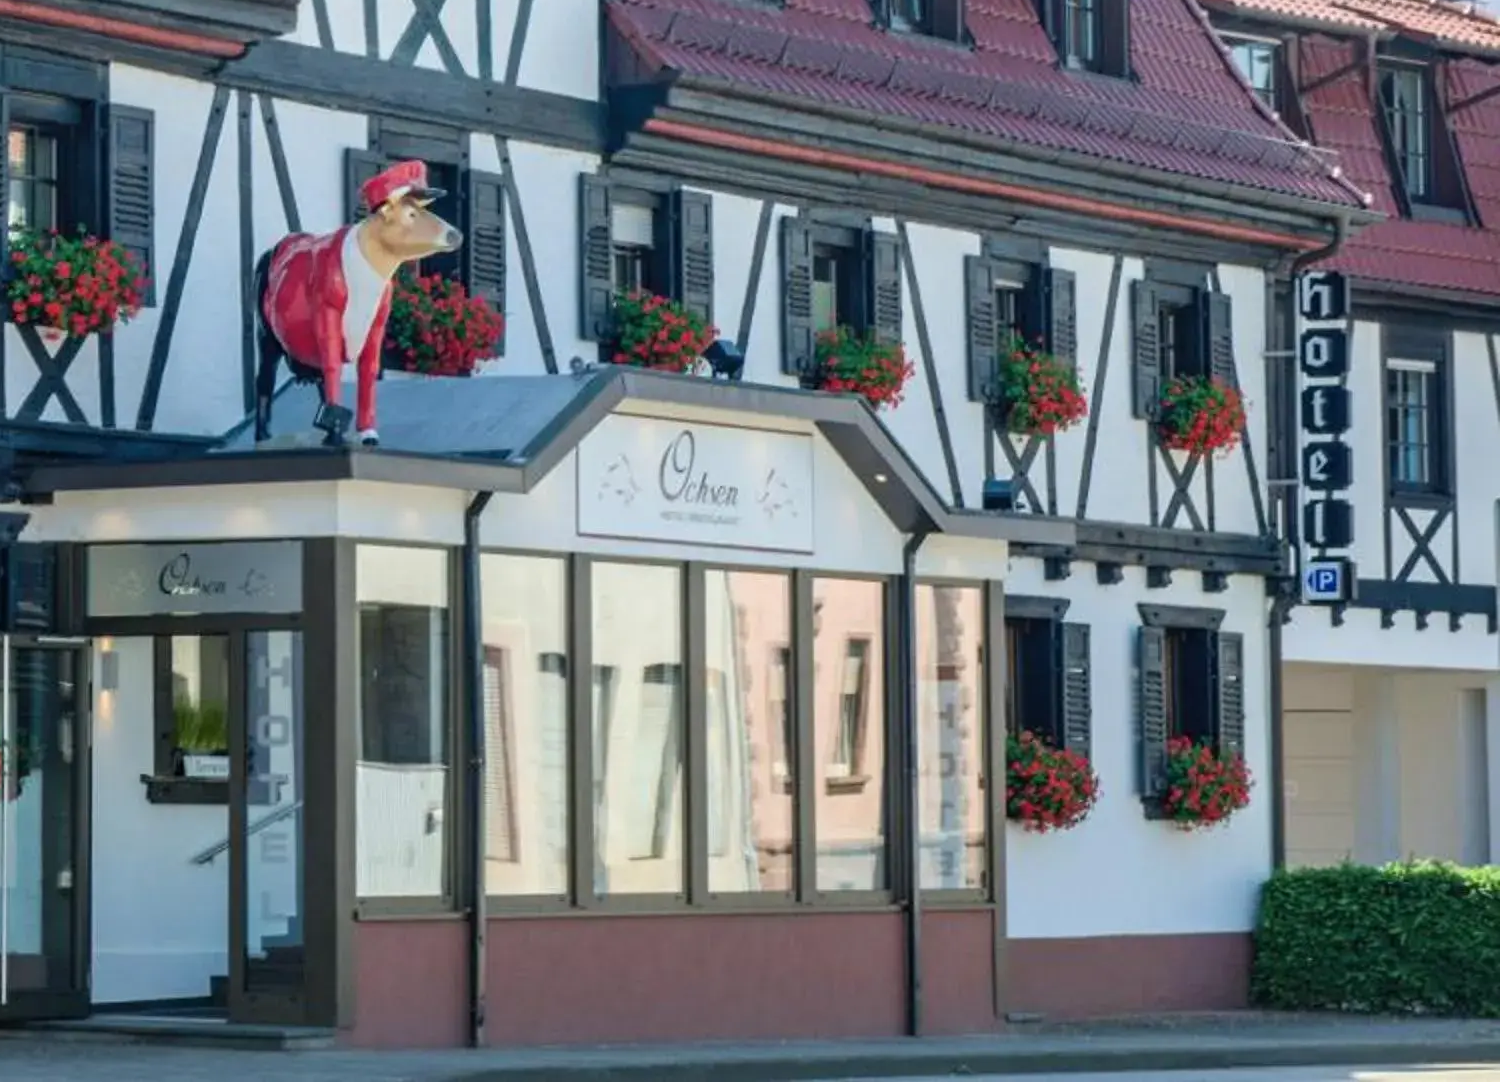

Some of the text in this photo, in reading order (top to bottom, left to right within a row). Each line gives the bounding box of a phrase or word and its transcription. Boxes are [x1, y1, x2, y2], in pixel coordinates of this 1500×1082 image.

[659, 429, 739, 507] Ochsen
[1301, 271, 1332, 544] hotel
[1320, 570, 1335, 592] P
[256, 655, 290, 924] HOTEL
